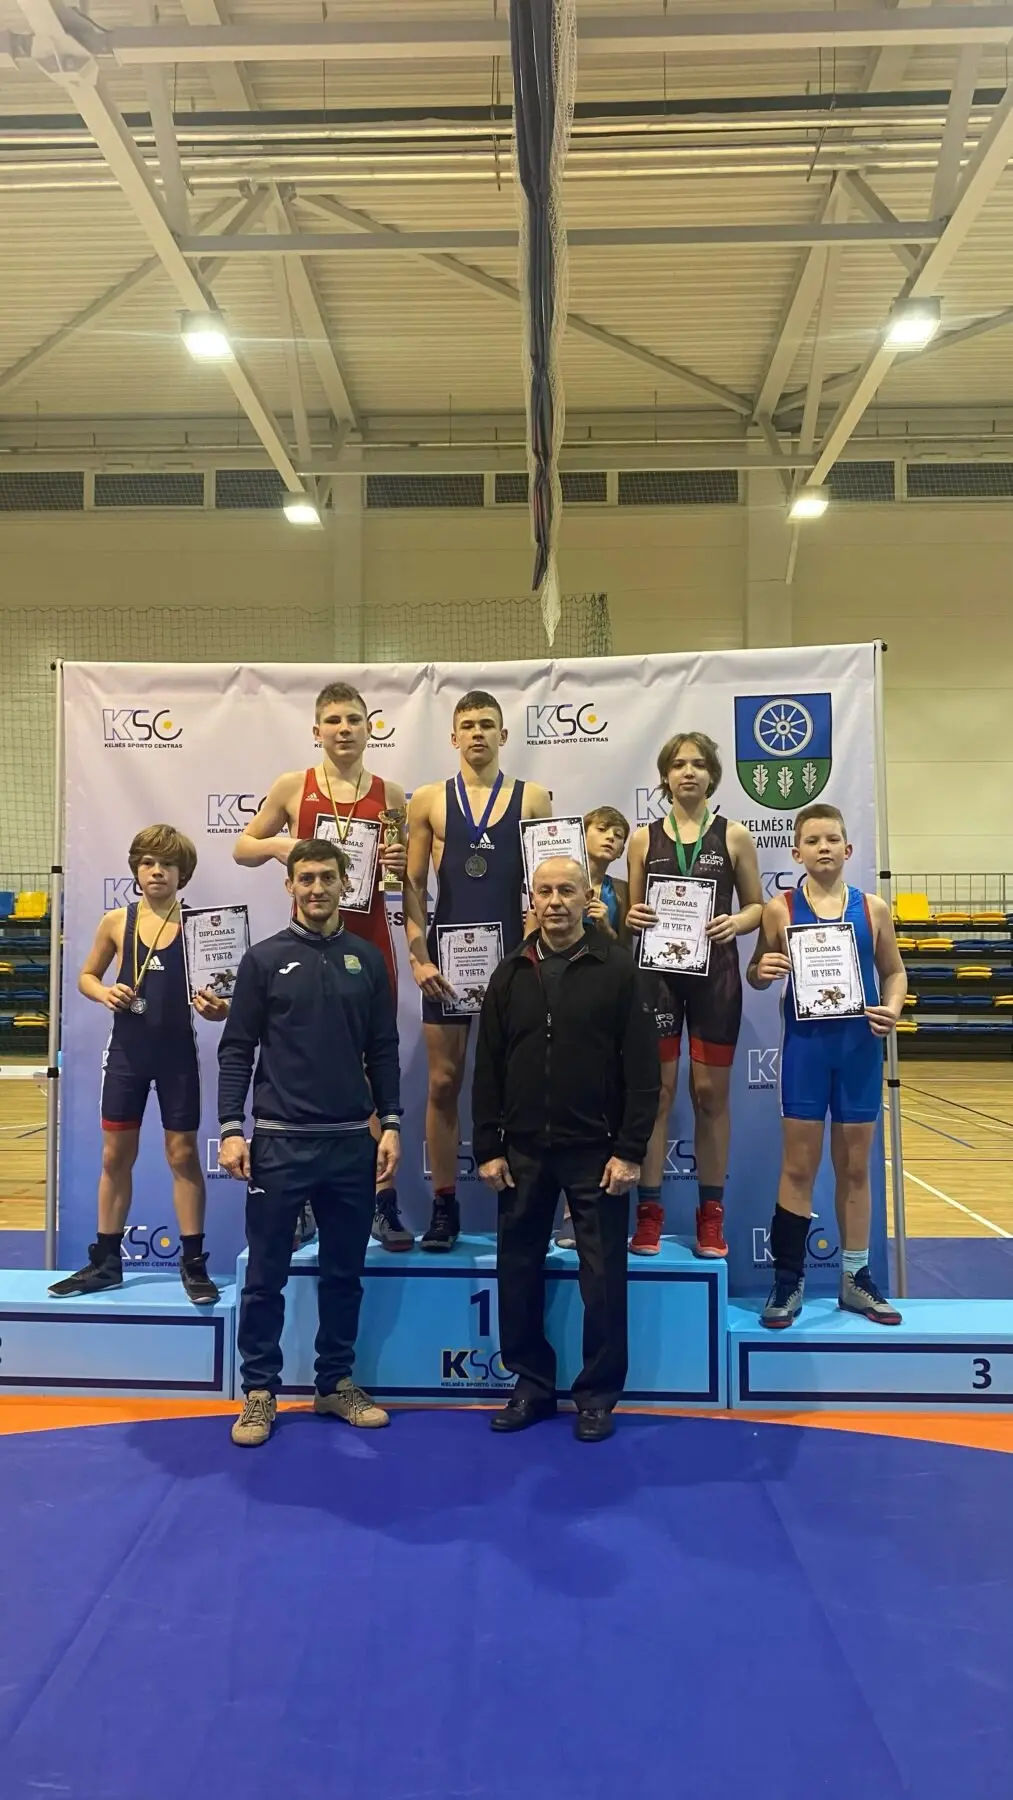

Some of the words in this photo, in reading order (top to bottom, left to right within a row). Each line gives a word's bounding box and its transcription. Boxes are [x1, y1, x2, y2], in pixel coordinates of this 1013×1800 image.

[102, 709, 183, 741] KSC
[527, 703, 608, 738] KSC
[537, 838, 571, 847] DIPLOMAS
[661, 898, 698, 908] DIPLOMAS
[198, 928, 236, 938] DIPLOMAS
[804, 945, 841, 953] DIPLOMAS
[752, 1227, 839, 1262] KC
[470, 1289, 490, 1337] 1
[972, 1357, 992, 1390] 3
